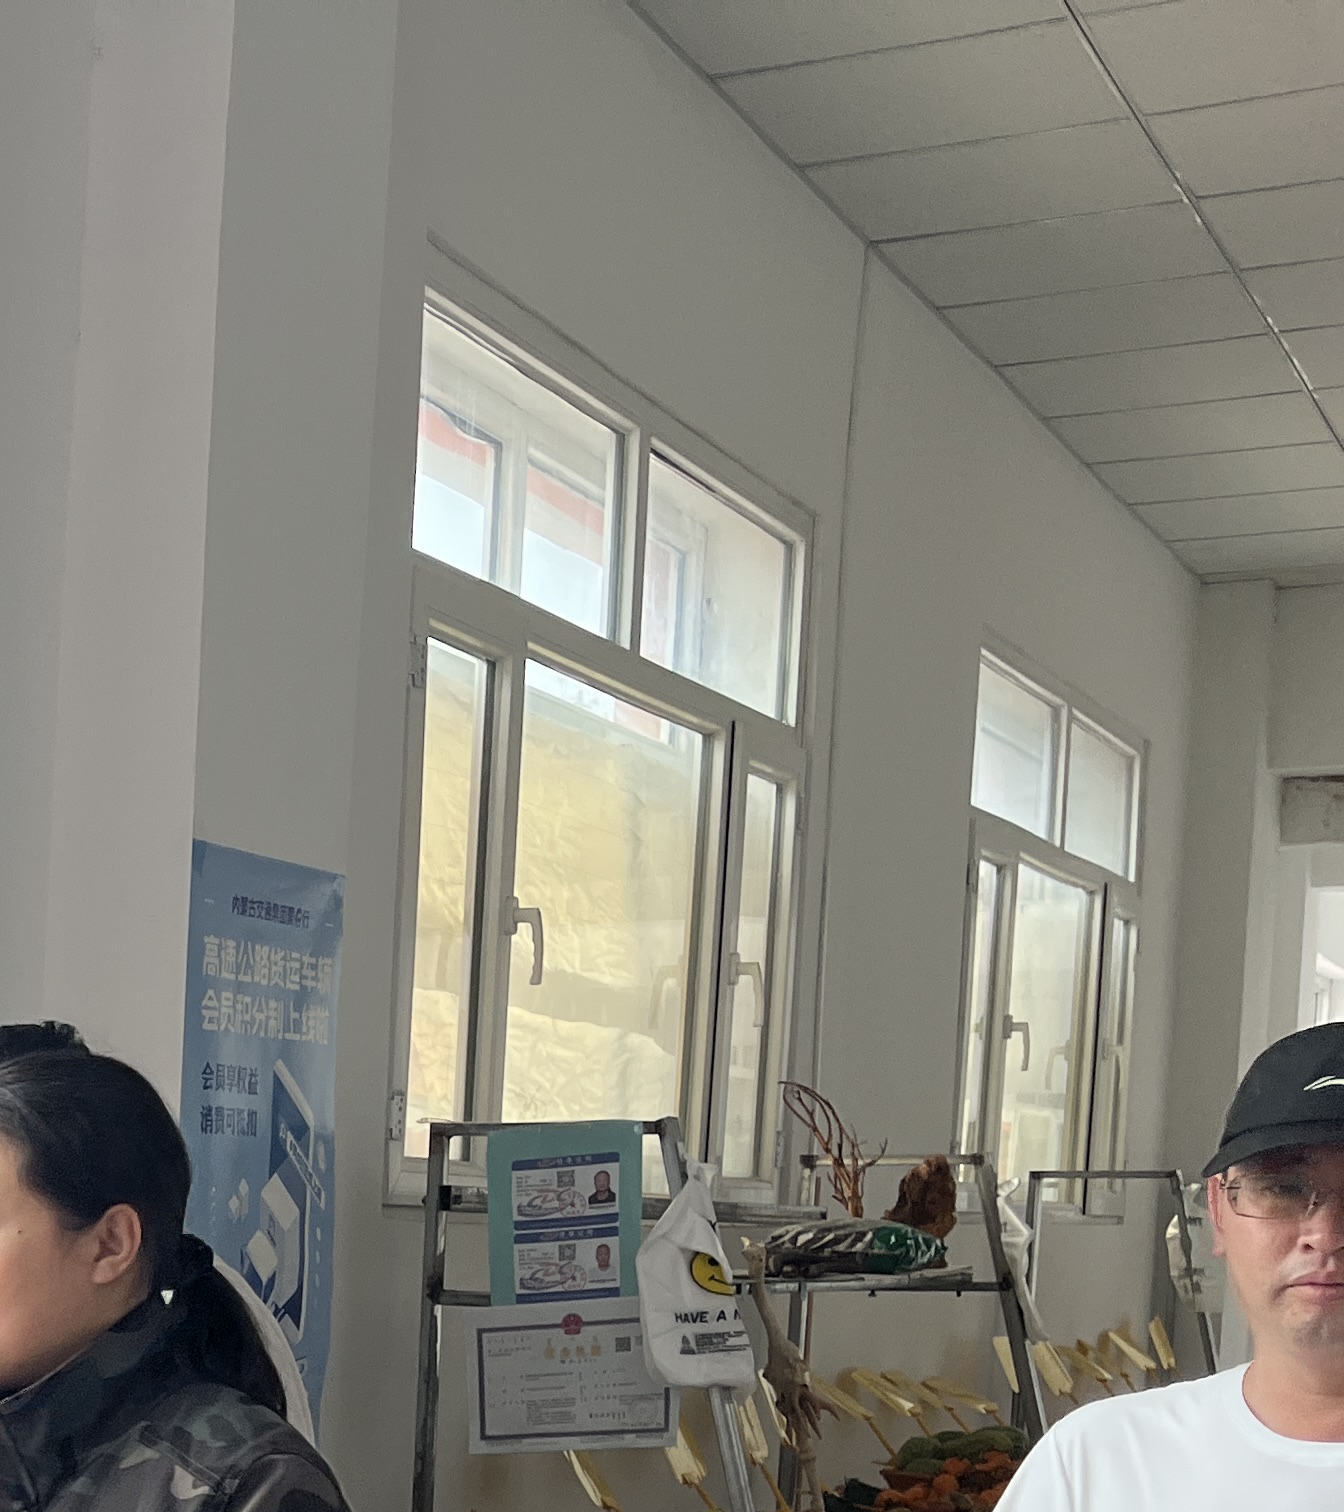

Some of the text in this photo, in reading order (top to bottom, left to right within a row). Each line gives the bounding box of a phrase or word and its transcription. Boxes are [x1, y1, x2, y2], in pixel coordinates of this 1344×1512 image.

[201, 1061, 259, 1095] 会员享权益
[674, 1311, 710, 1324] HAVE
[716, 1309, 727, 1322] A
